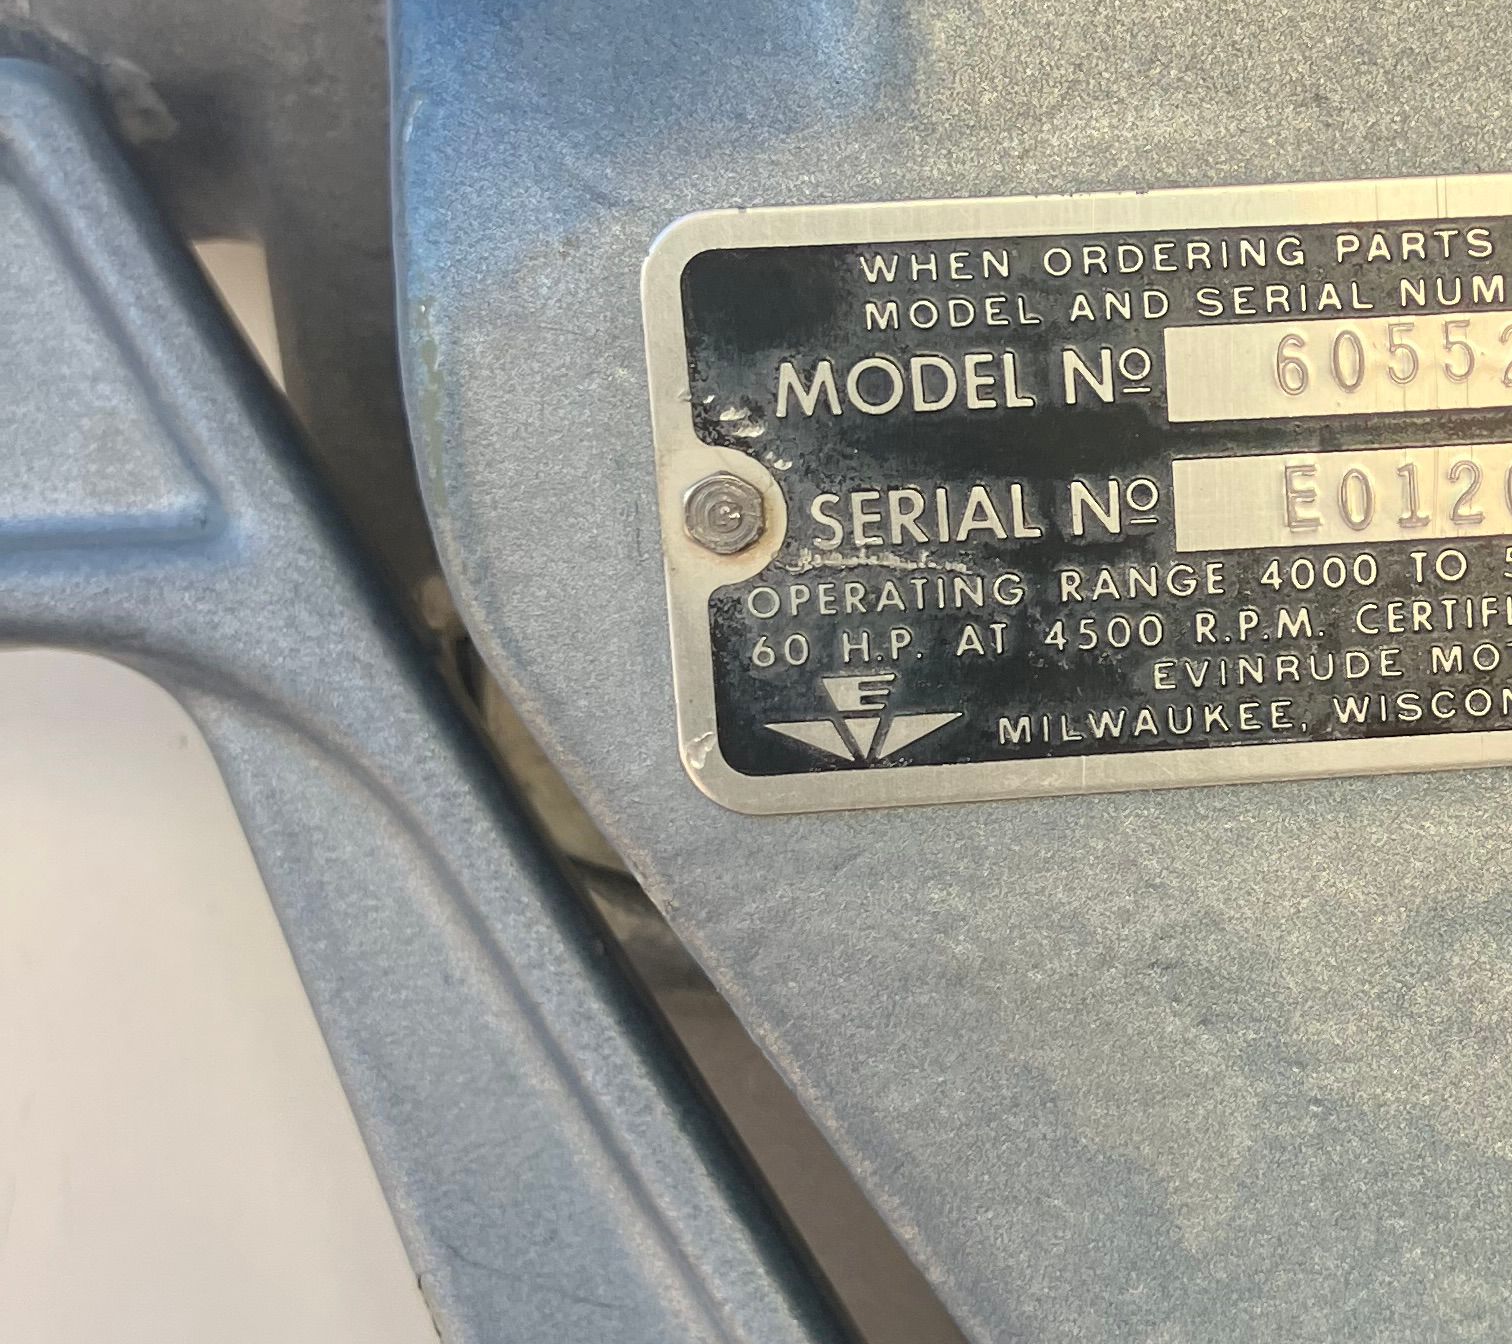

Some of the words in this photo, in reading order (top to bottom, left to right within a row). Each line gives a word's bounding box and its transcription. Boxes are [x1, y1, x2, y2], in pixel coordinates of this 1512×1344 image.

[859, 250, 1010, 284] WHEN
[1043, 236, 1305, 277] ORDERING
[1336, 227, 1495, 263] PARTS
[865, 296, 1041, 330] MODEL
[1070, 287, 1170, 322] AND
[1196, 276, 1374, 316] SERIAL
[774, 352, 1035, 418] MODEL
[810, 482, 1043, 549] SERIAL
[746, 571, 1025, 619] OPERATING
[1060, 562, 1226, 602] RANGE
[1260, 553, 1378, 591] 4000
[1411, 548, 1468, 584] TO
[751, 634, 810, 668] 60
[843, 626, 922, 663] H.P.
[956, 622, 1006, 656] AT
[1043, 613, 1164, 651] 4500
[1153, 648, 1404, 690] EVINRUDE
[998, 699, 1309, 746] MILWAUKEE,
